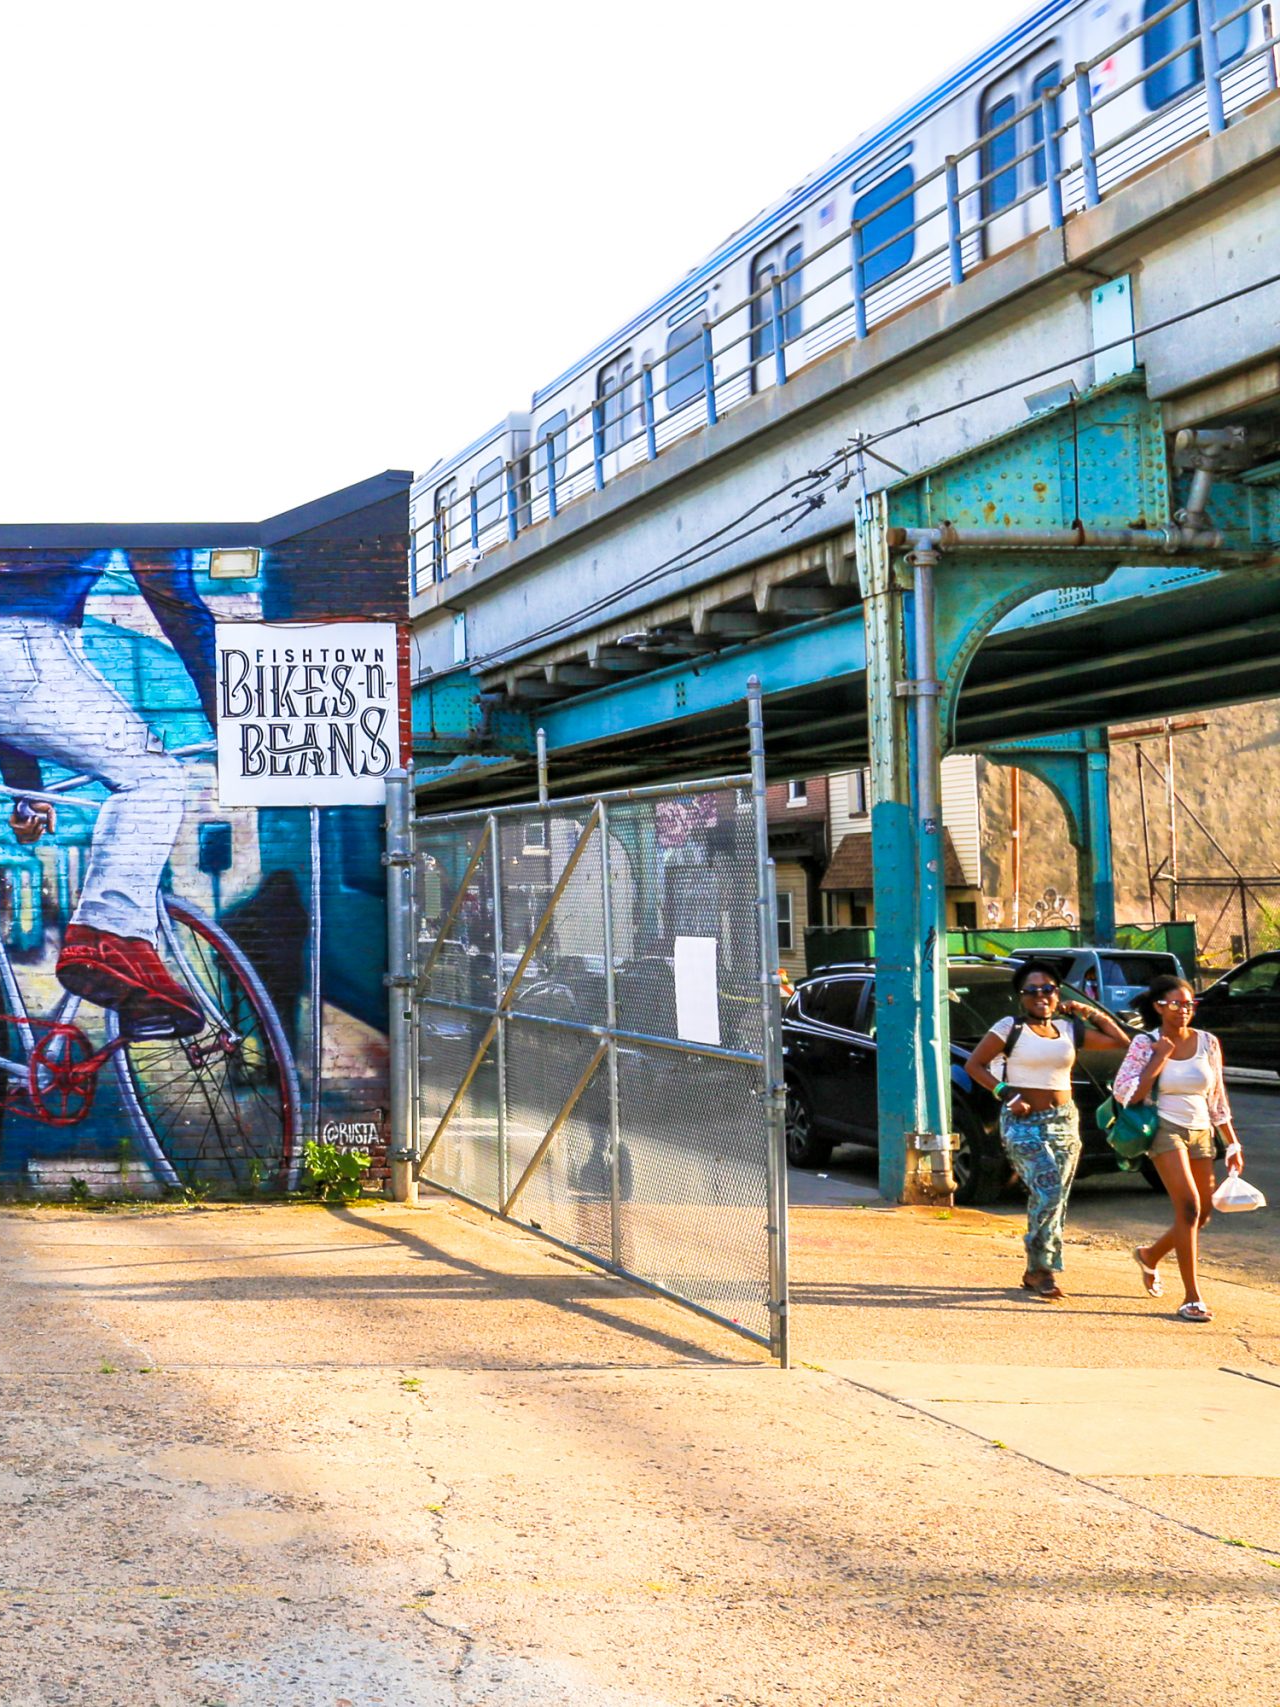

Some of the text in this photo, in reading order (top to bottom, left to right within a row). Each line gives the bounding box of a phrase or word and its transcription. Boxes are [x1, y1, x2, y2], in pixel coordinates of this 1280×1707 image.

[220, 650, 357, 718] BIKES
[256, 649, 384, 663] FISHTOWN
[239, 706, 392, 777] BEANS
